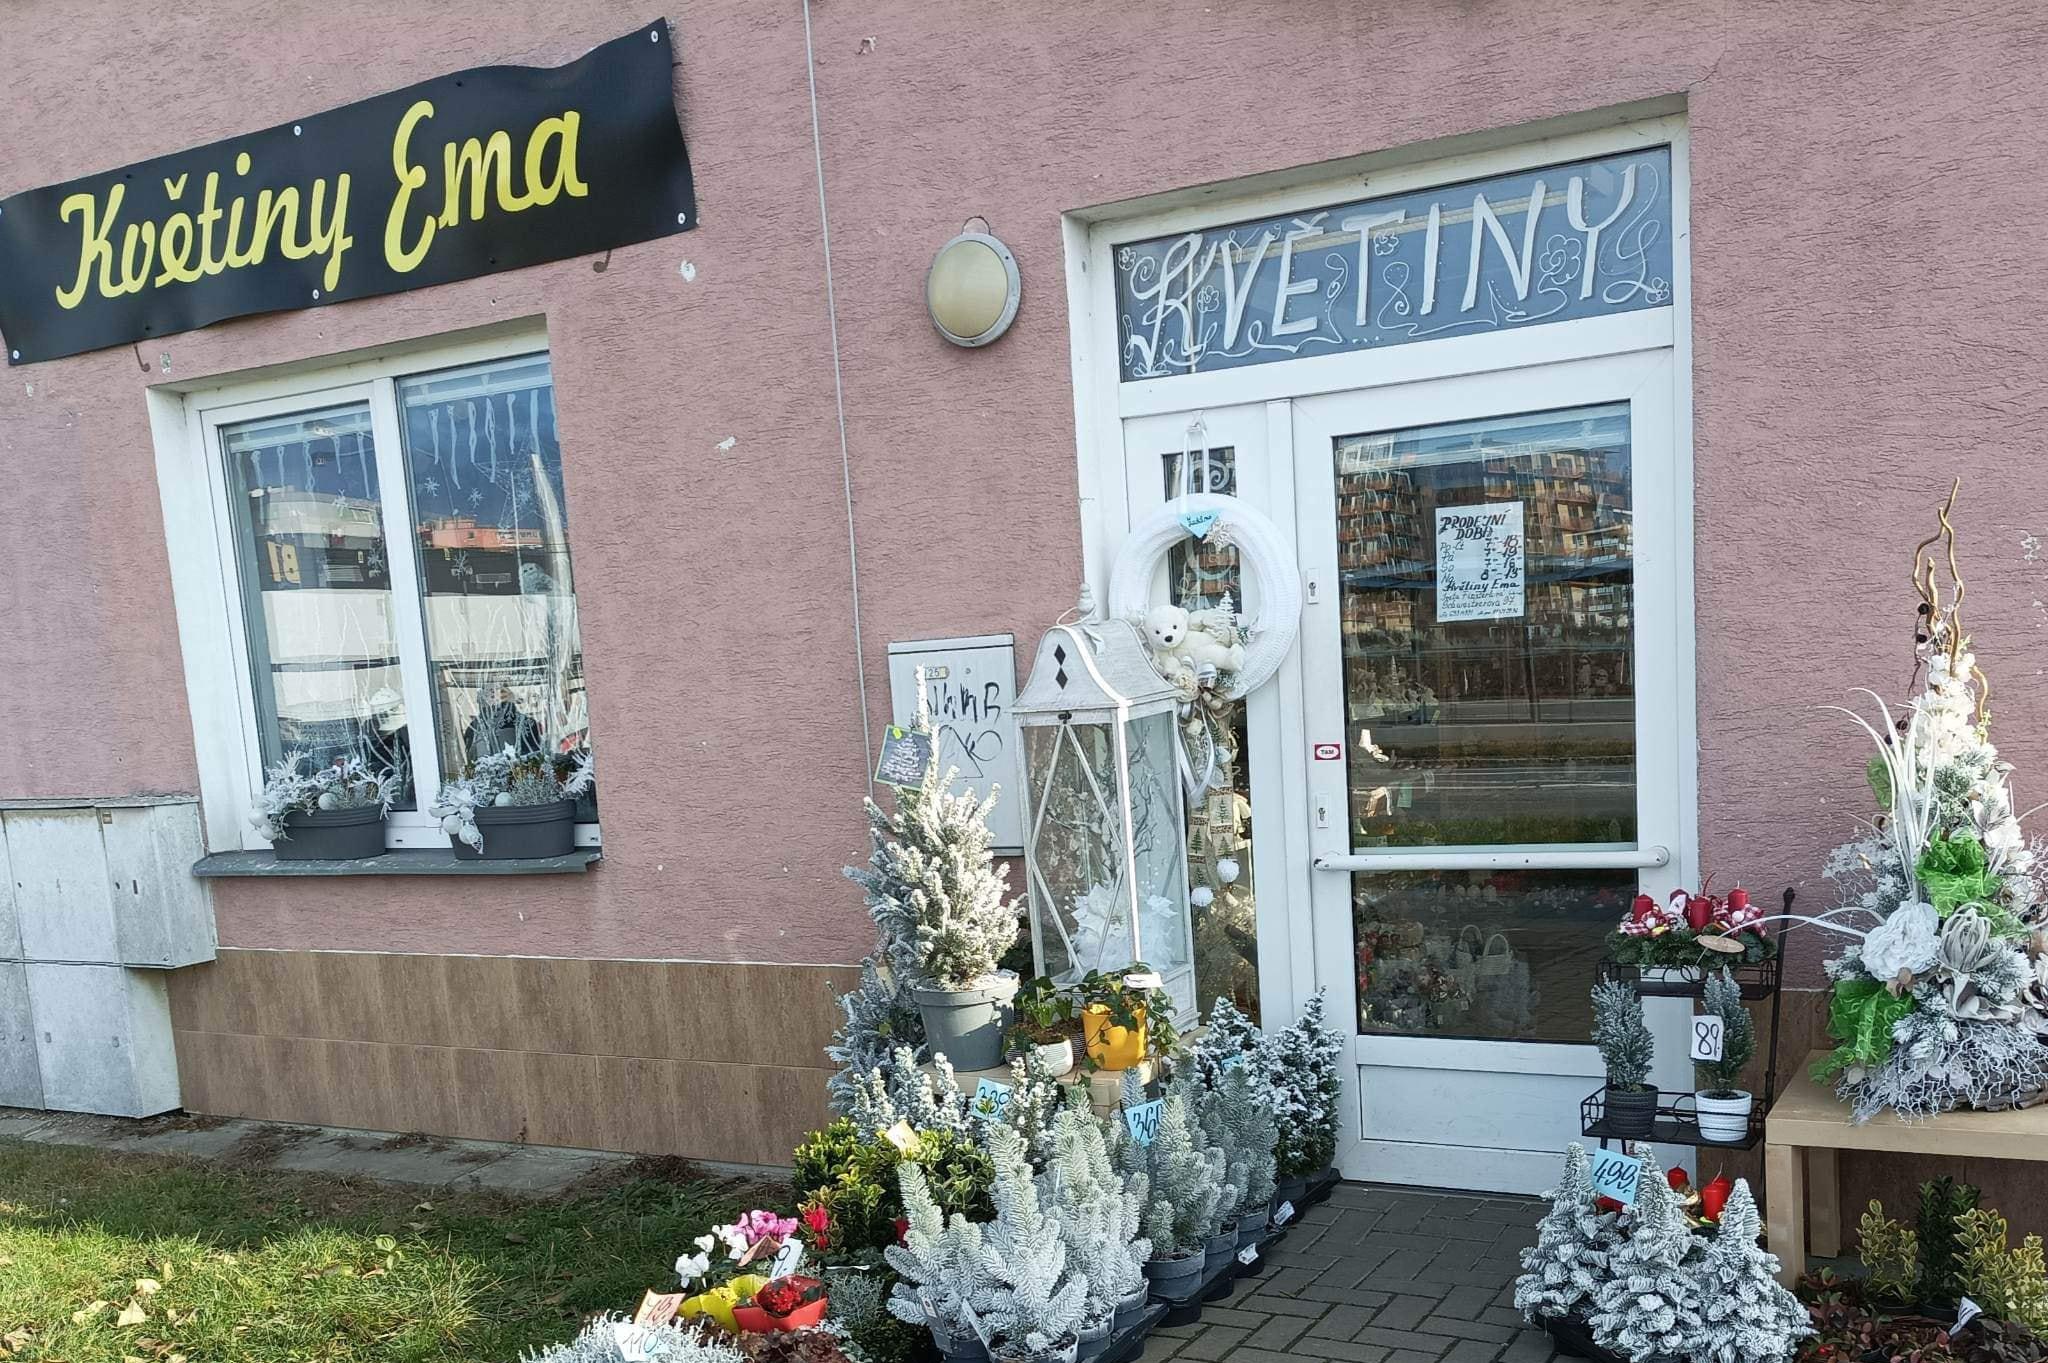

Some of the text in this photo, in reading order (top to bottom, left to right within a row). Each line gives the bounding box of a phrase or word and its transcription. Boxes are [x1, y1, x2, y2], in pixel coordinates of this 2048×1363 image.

[56, 100, 589, 309] Květiny Ema
[1130, 163, 1636, 373] KVĚTINY
[1454, 526, 1494, 540] DOBA
[1491, 579, 1520, 589] Ema
